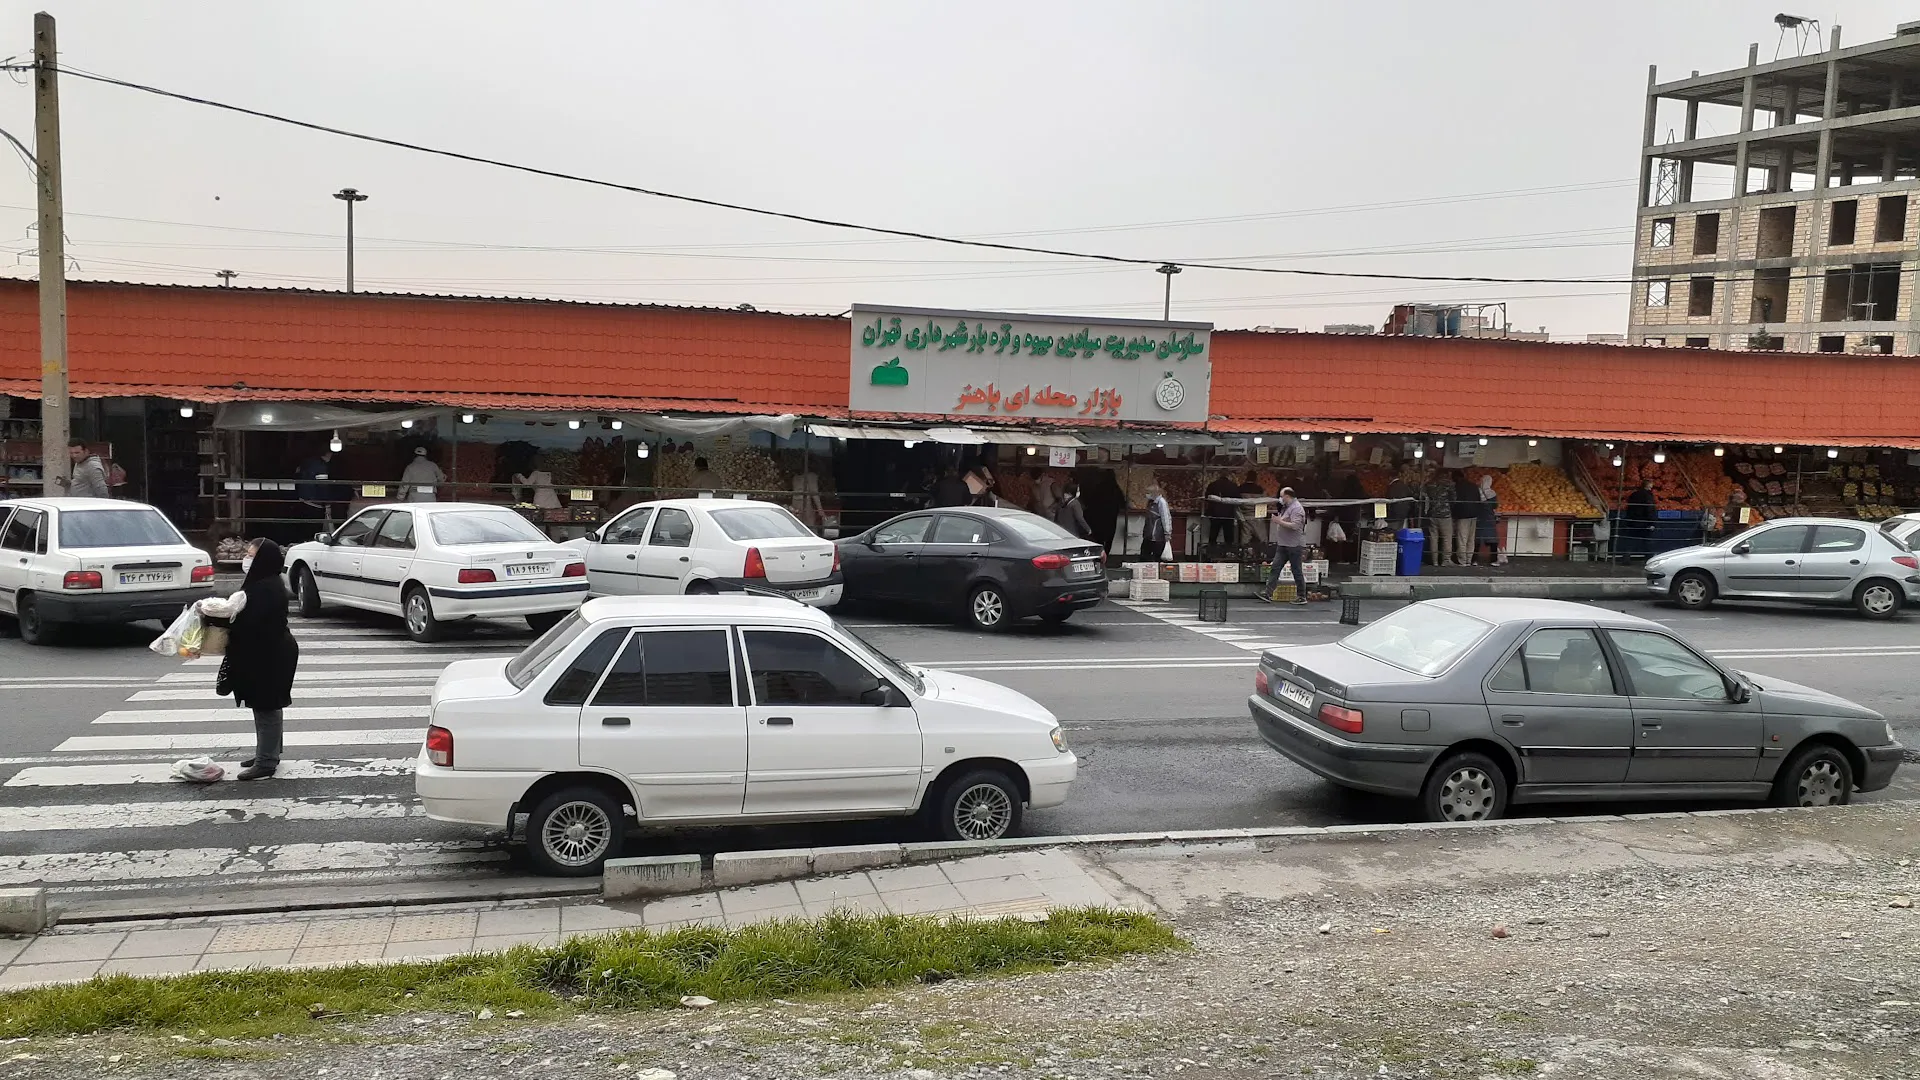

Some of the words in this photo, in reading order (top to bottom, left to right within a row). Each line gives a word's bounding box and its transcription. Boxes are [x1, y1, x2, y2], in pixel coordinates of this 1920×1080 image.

[862, 316, 902, 348] تهران
[905, 319, 968, 353] شهرداری
[966, 323, 988, 354] بار
[990, 323, 1012, 354] تره
[1010, 334, 1021, 355] و
[1023, 333, 1054, 356] میوه
[1055, 327, 1102, 358] میادین
[1157, 330, 1204, 363] سازمان
[1104, 334, 1156, 361] مدیریت
[953, 382, 1001, 412] باهنر
[1004, 384, 1030, 411] ای
[1033, 384, 1078, 407] محله
[1078, 387, 1122, 417] بازار
[1054, 450, 1071, 460] ورود
